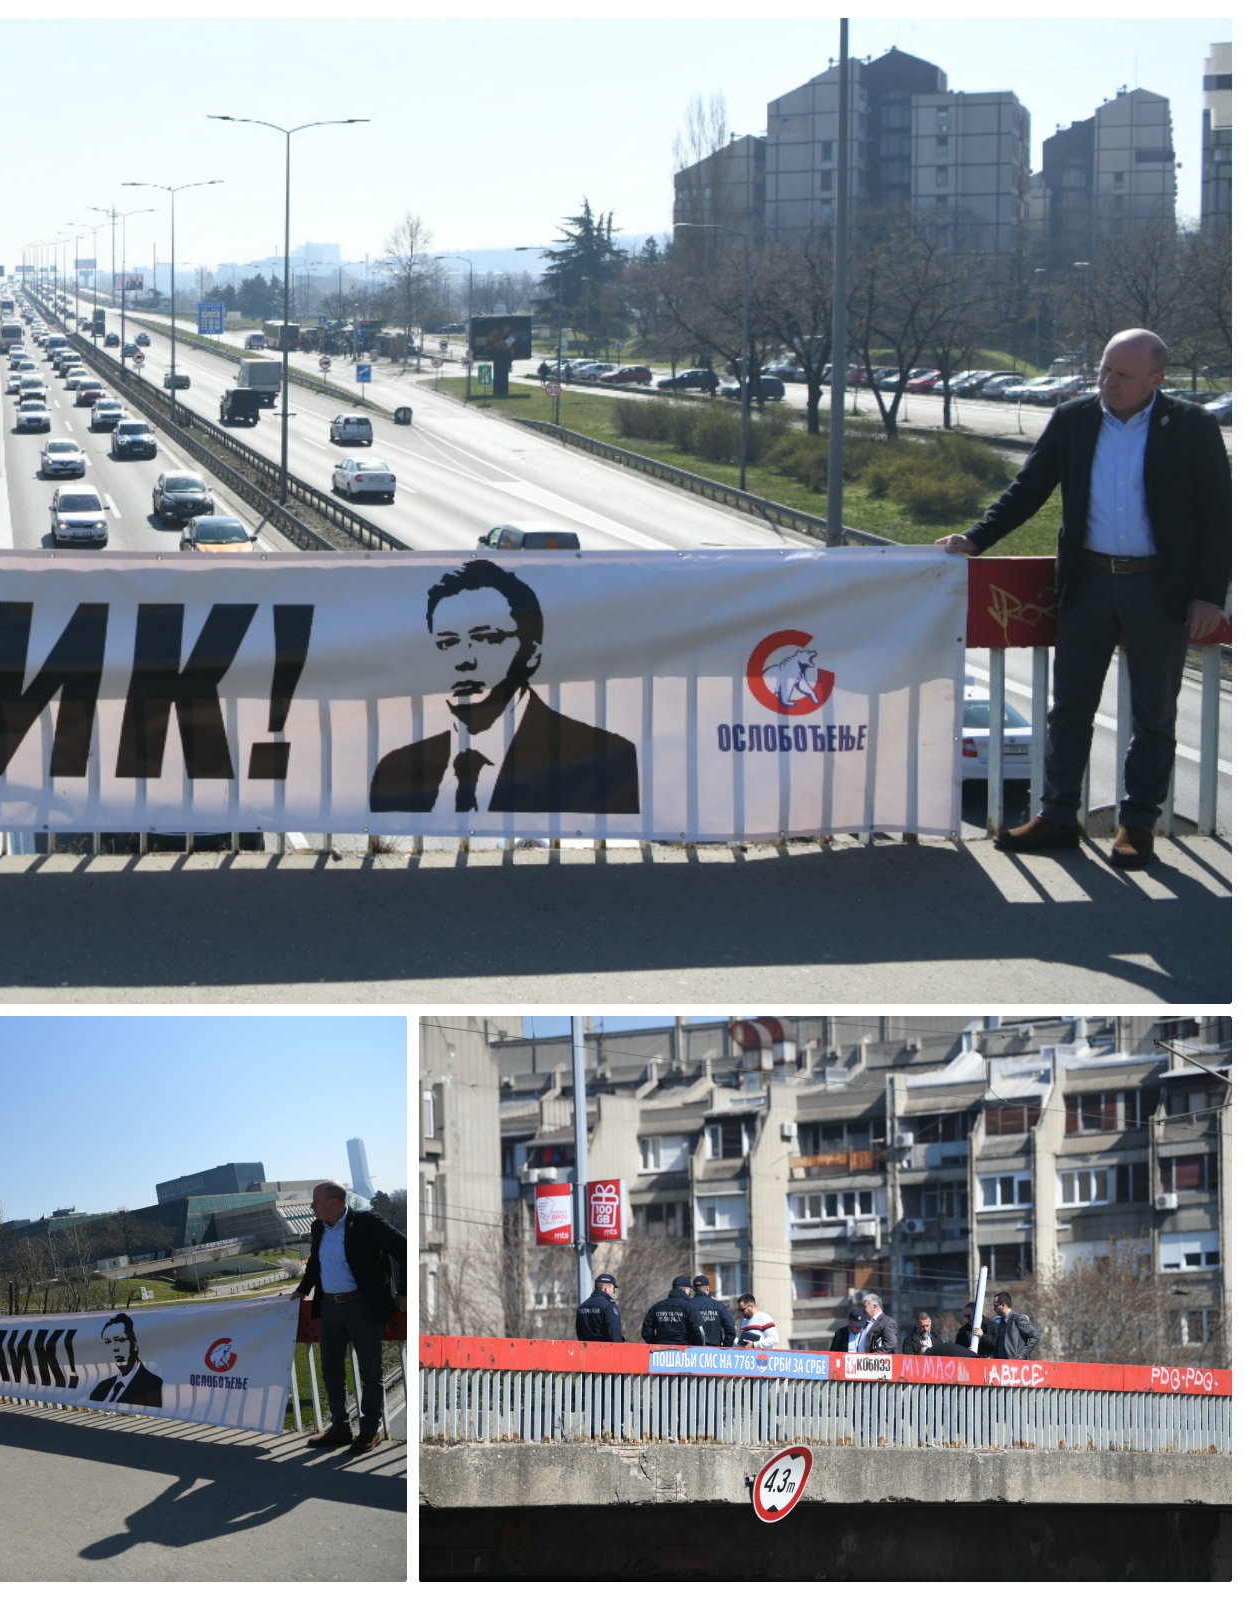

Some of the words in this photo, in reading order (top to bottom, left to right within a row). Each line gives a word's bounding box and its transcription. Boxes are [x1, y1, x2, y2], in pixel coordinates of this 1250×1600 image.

[717, 723, 868, 752] ОСЛОБОЂЕЊЕ
[595, 1204, 613, 1215] 100
[596, 1214, 611, 1223] GB
[554, 1231, 569, 1239] mts
[604, 1228, 618, 1236] mts
[652, 1351, 697, 1368] ПОШАЉИ
[699, 1353, 718, 1369] СМС
[720, 1355, 732, 1369] НА
[734, 1355, 756, 1370] 7763
[768, 1356, 791, 1373] СРБИ
[792, 1357, 804, 1373] ЗА
[805, 1358, 827, 1375] СРБЕ
[190, 1373, 248, 1390] ОСЛОБОЂЕЊЕ
